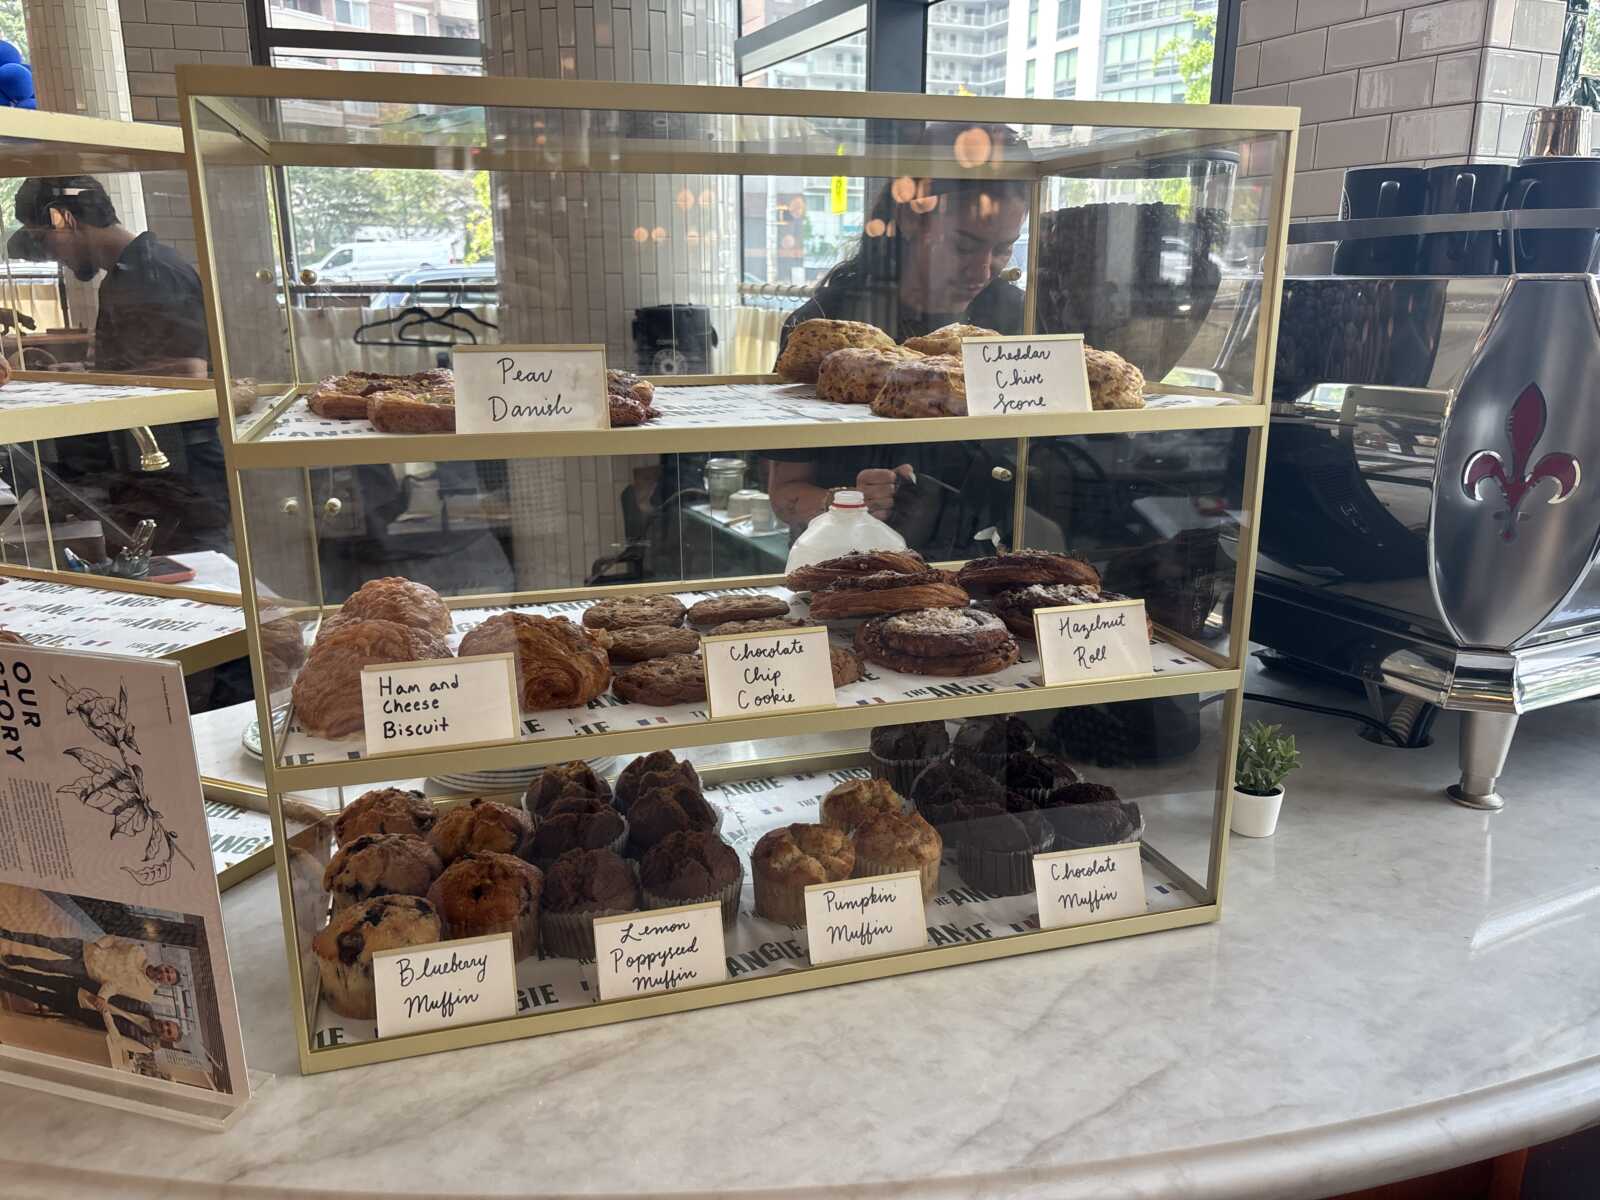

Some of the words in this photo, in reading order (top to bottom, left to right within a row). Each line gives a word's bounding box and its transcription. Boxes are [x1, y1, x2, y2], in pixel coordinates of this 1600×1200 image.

[983, 345, 1051, 363] Cheddar
[497, 357, 553, 385] Pear
[996, 369, 1044, 389] Chive
[488, 394, 573, 422] Danish
[1059, 613, 1125, 639] Hazelnut
[730, 639, 804, 662] Chocolate
[1073, 645, 1106, 669] Roll
[379, 676, 421, 697] Ham
[429, 674, 459, 693] and
[744, 666, 781, 686] Chip
[12, 661, 41, 728] OUR
[383, 698, 440, 714] Cheese
[738, 688, 795, 710] Cookie
[0, 661, 24, 763] TORY
[383, 717, 449, 740] Biscuit
[721, 775, 785, 800] ANGIE
[1051, 856, 1116, 881] Chocolate
[823, 886, 897, 914] Pumpkin
[1058, 885, 1118, 913] Muffin
[620, 920, 690, 944] Lemon
[826, 920, 893, 946] Muffin
[610, 936, 699, 974] Poppyseed
[726, 940, 806, 977] ANGIE
[396, 951, 488, 987] Blueberry
[632, 967, 697, 991] Muffin
[403, 989, 480, 1019] Muffin
